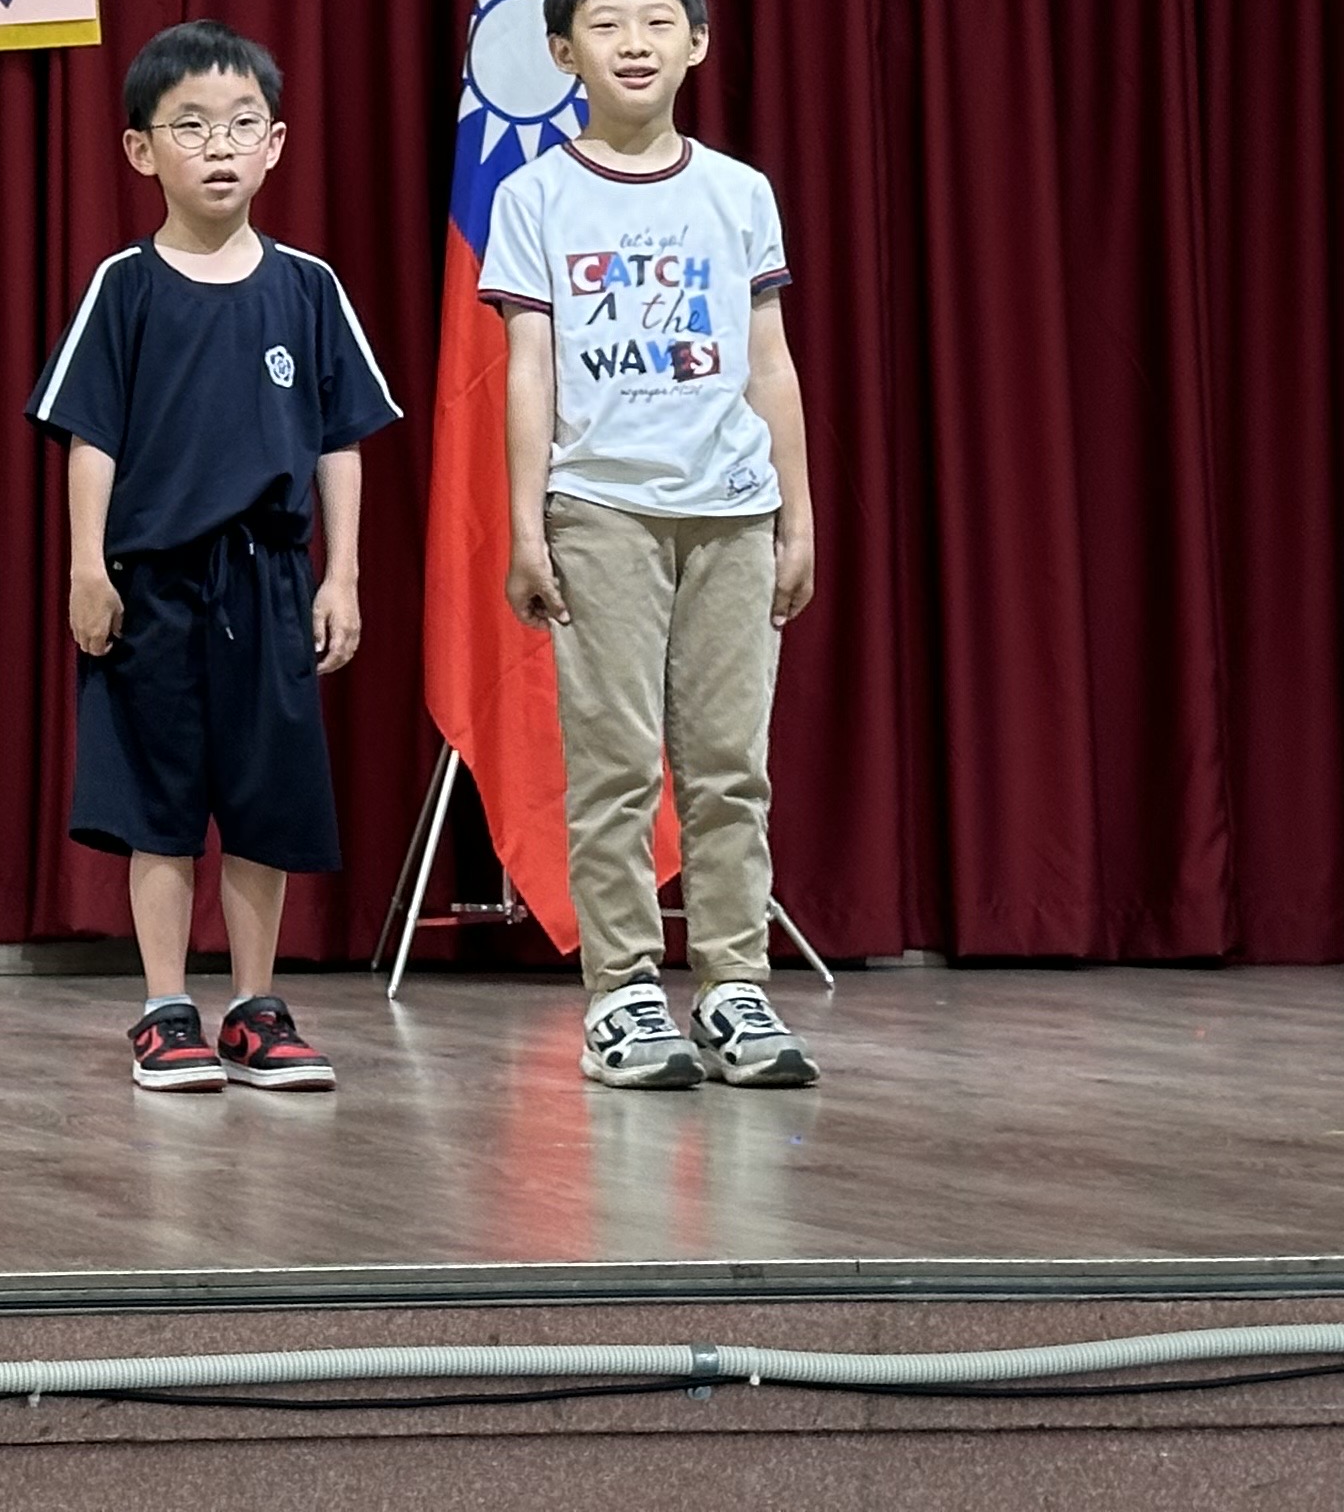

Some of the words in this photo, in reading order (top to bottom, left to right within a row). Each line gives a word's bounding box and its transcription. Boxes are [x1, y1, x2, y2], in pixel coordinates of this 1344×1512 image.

[571, 253, 711, 292] CATCH
[641, 289, 705, 335] the
[580, 338, 720, 383] WAVES
